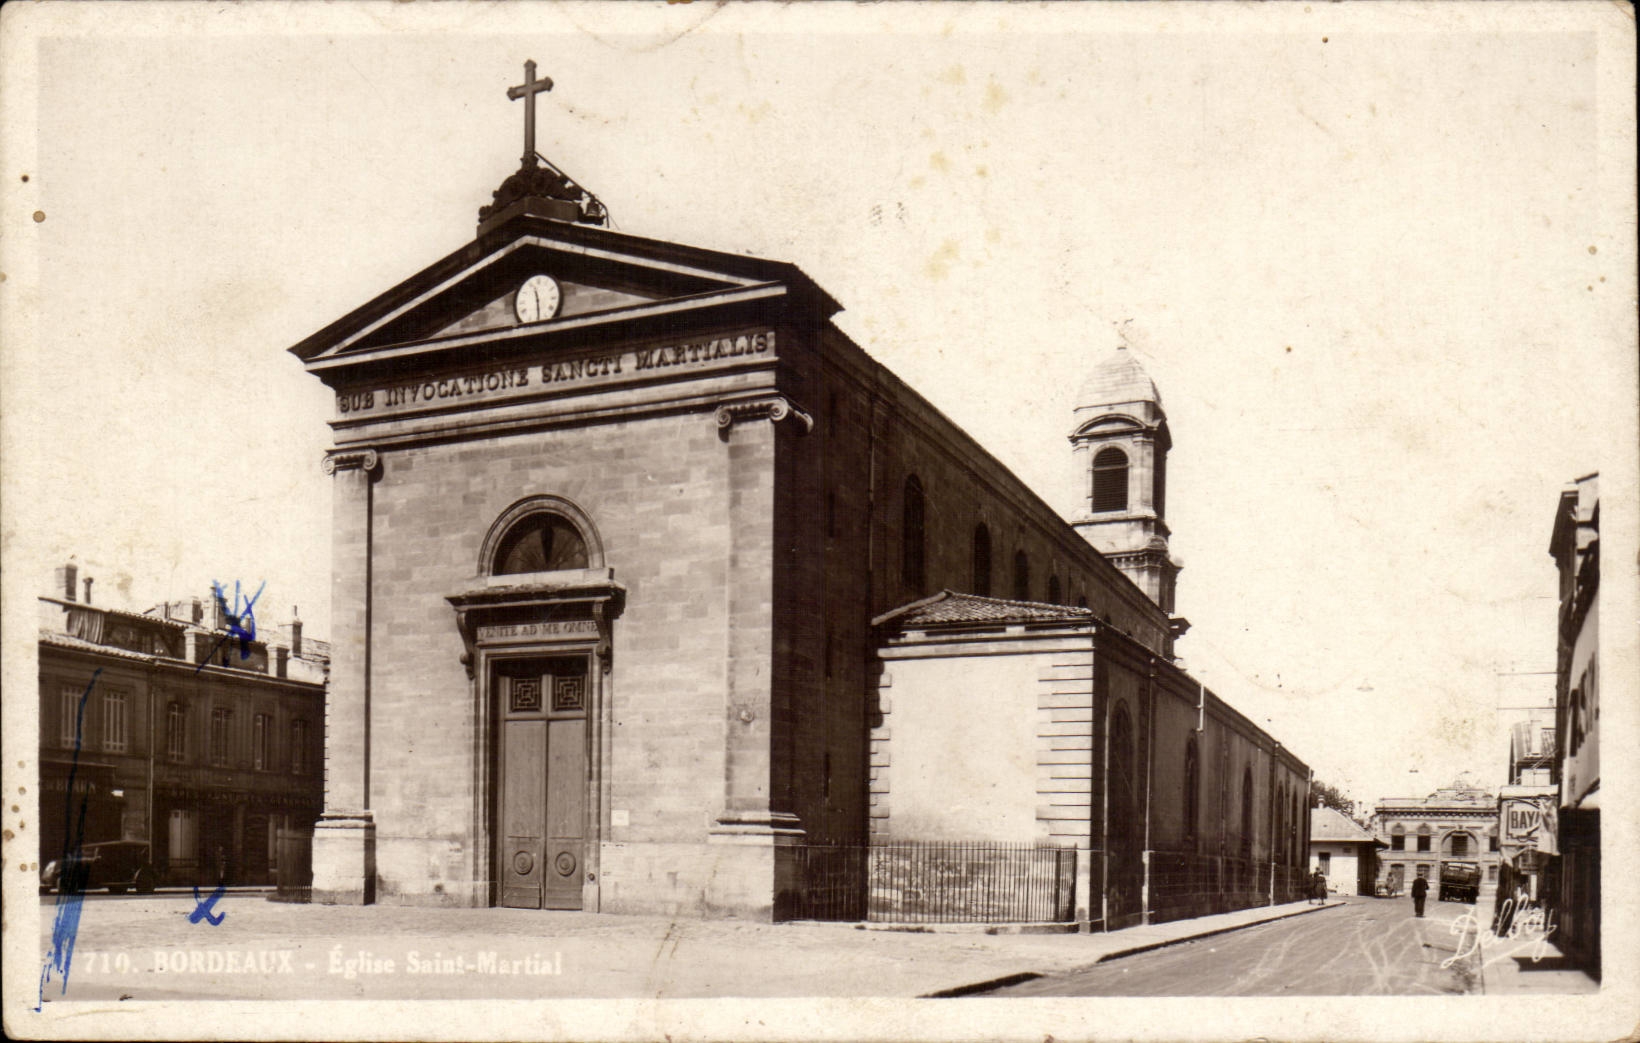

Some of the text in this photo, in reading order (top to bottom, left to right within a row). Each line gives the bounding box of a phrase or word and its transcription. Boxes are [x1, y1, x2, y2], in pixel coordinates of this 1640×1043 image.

[340, 334, 768, 413] SUB INVOCATIONE SANCTI MARTIALIS
[521, 625, 538, 636] AD
[563, 621, 599, 634] OMNE
